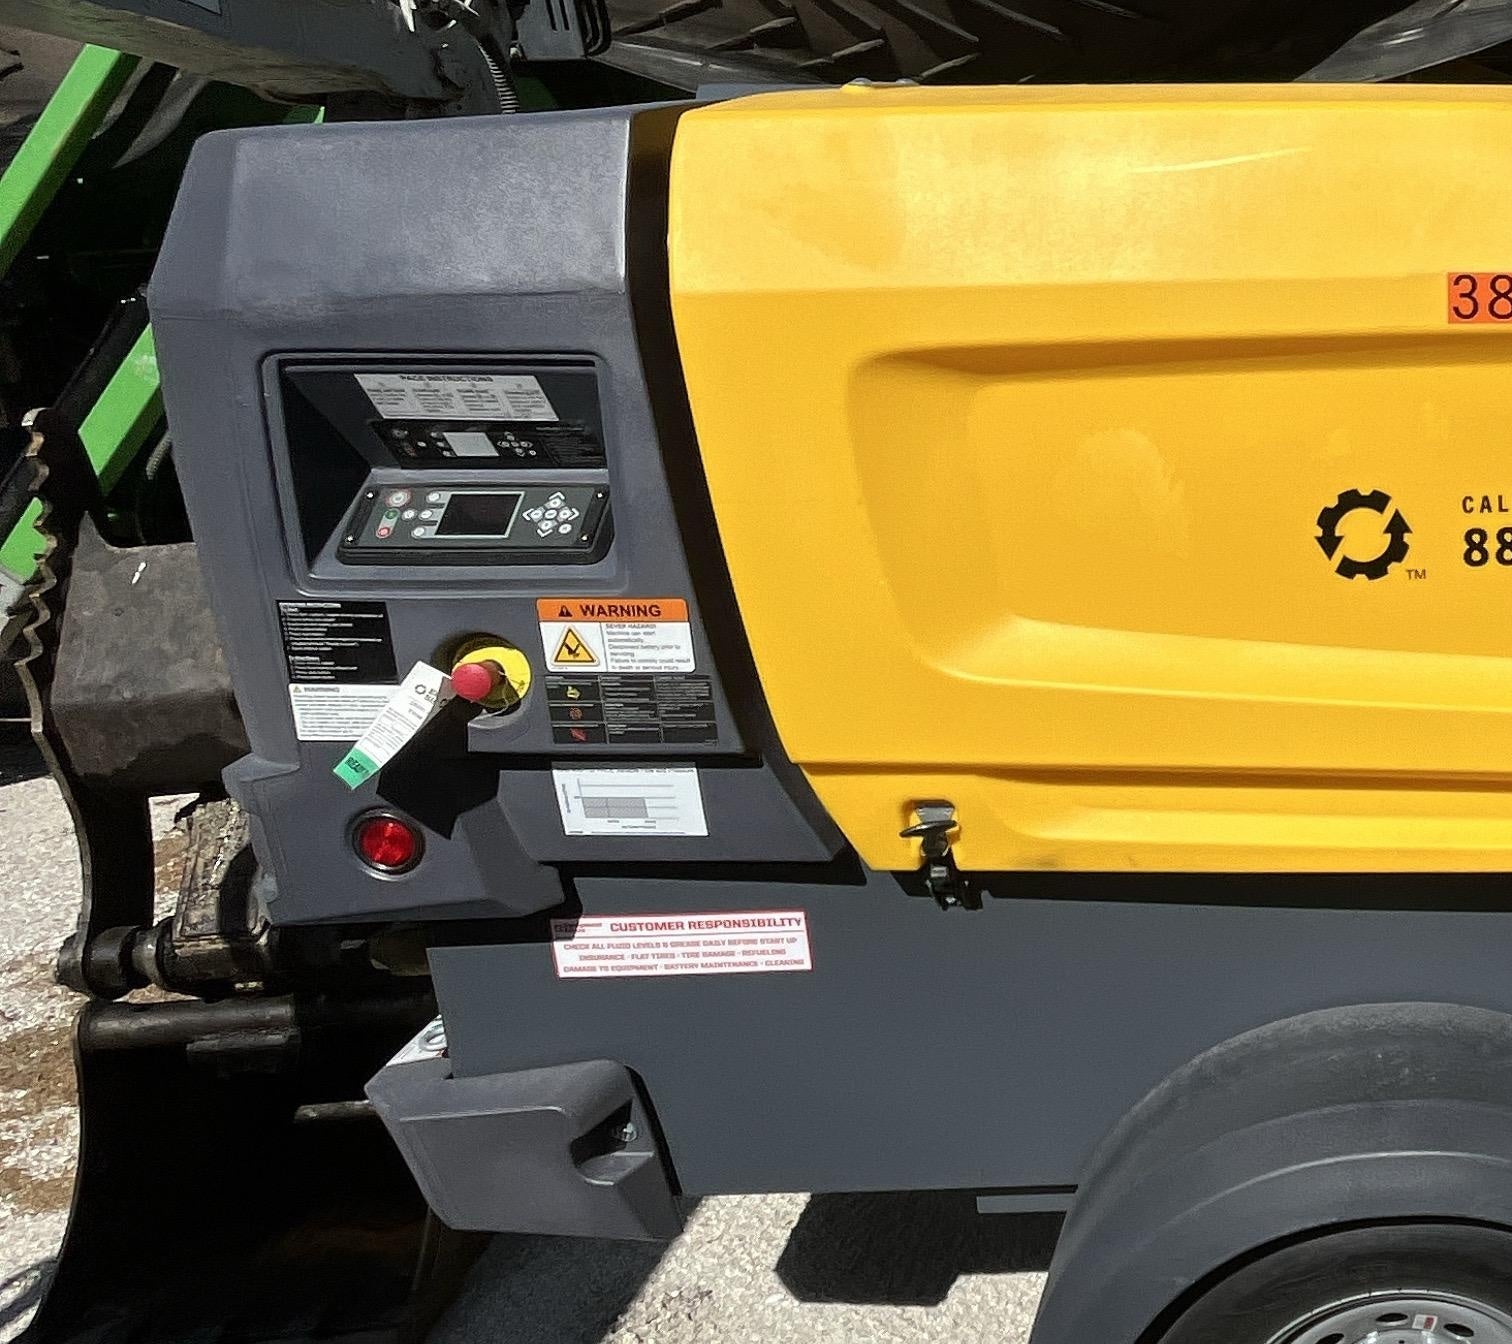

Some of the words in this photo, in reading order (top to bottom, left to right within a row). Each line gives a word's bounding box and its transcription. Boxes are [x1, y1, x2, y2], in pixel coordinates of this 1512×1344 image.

[579, 604, 662, 617] WARNING
[610, 921, 685, 932] CUSTOMER
[688, 917, 802, 930] RESPONSIBILITY
[592, 942, 605, 950] ALL
